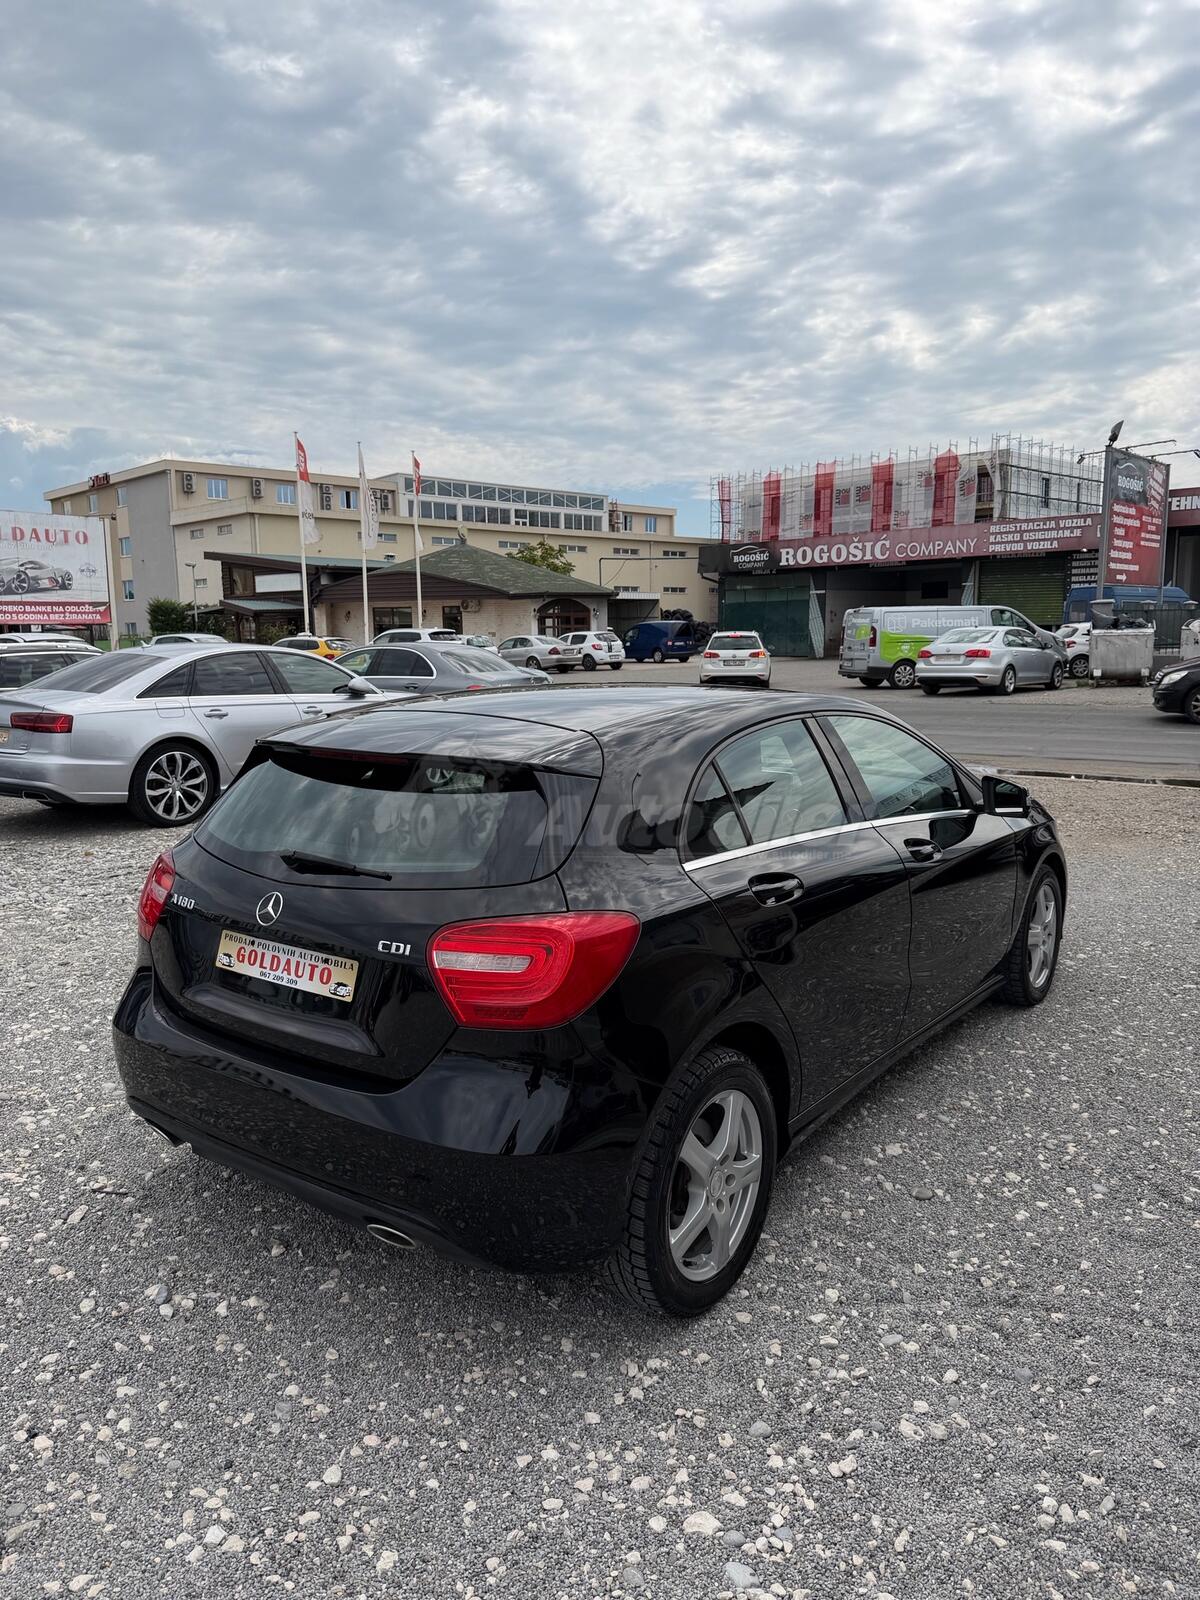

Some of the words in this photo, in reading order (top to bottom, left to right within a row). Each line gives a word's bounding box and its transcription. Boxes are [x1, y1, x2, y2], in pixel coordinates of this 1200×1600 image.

[1168, 496, 1200, 511] EHN
[990, 520, 1056, 533] REGISTRACIJA
[1059, 517, 1092, 528] VOZILA
[989, 533, 1021, 543] KASKO
[1023, 528, 1083, 541] OSIGURANJE
[779, 534, 890, 566] ROGOŠIĆ
[895, 538, 978, 559] COMPANY
[989, 542, 1024, 553] PREVOD
[1027, 540, 1058, 550] VOZILA
[733, 550, 769, 563] ROGOŠIĆ
[738, 561, 765, 569] COMPANY
[171, 893, 195, 909] A180
[257, 941, 296, 957] POLOVNIH
[298, 951, 354, 971] AUTOMOBILA
[378, 940, 411, 956] CDI
[236, 946, 332, 985] GOLDAUTO
[260, 970, 271, 979] 067
[272, 974, 284, 983] 209
[286, 978, 298, 986] 309
